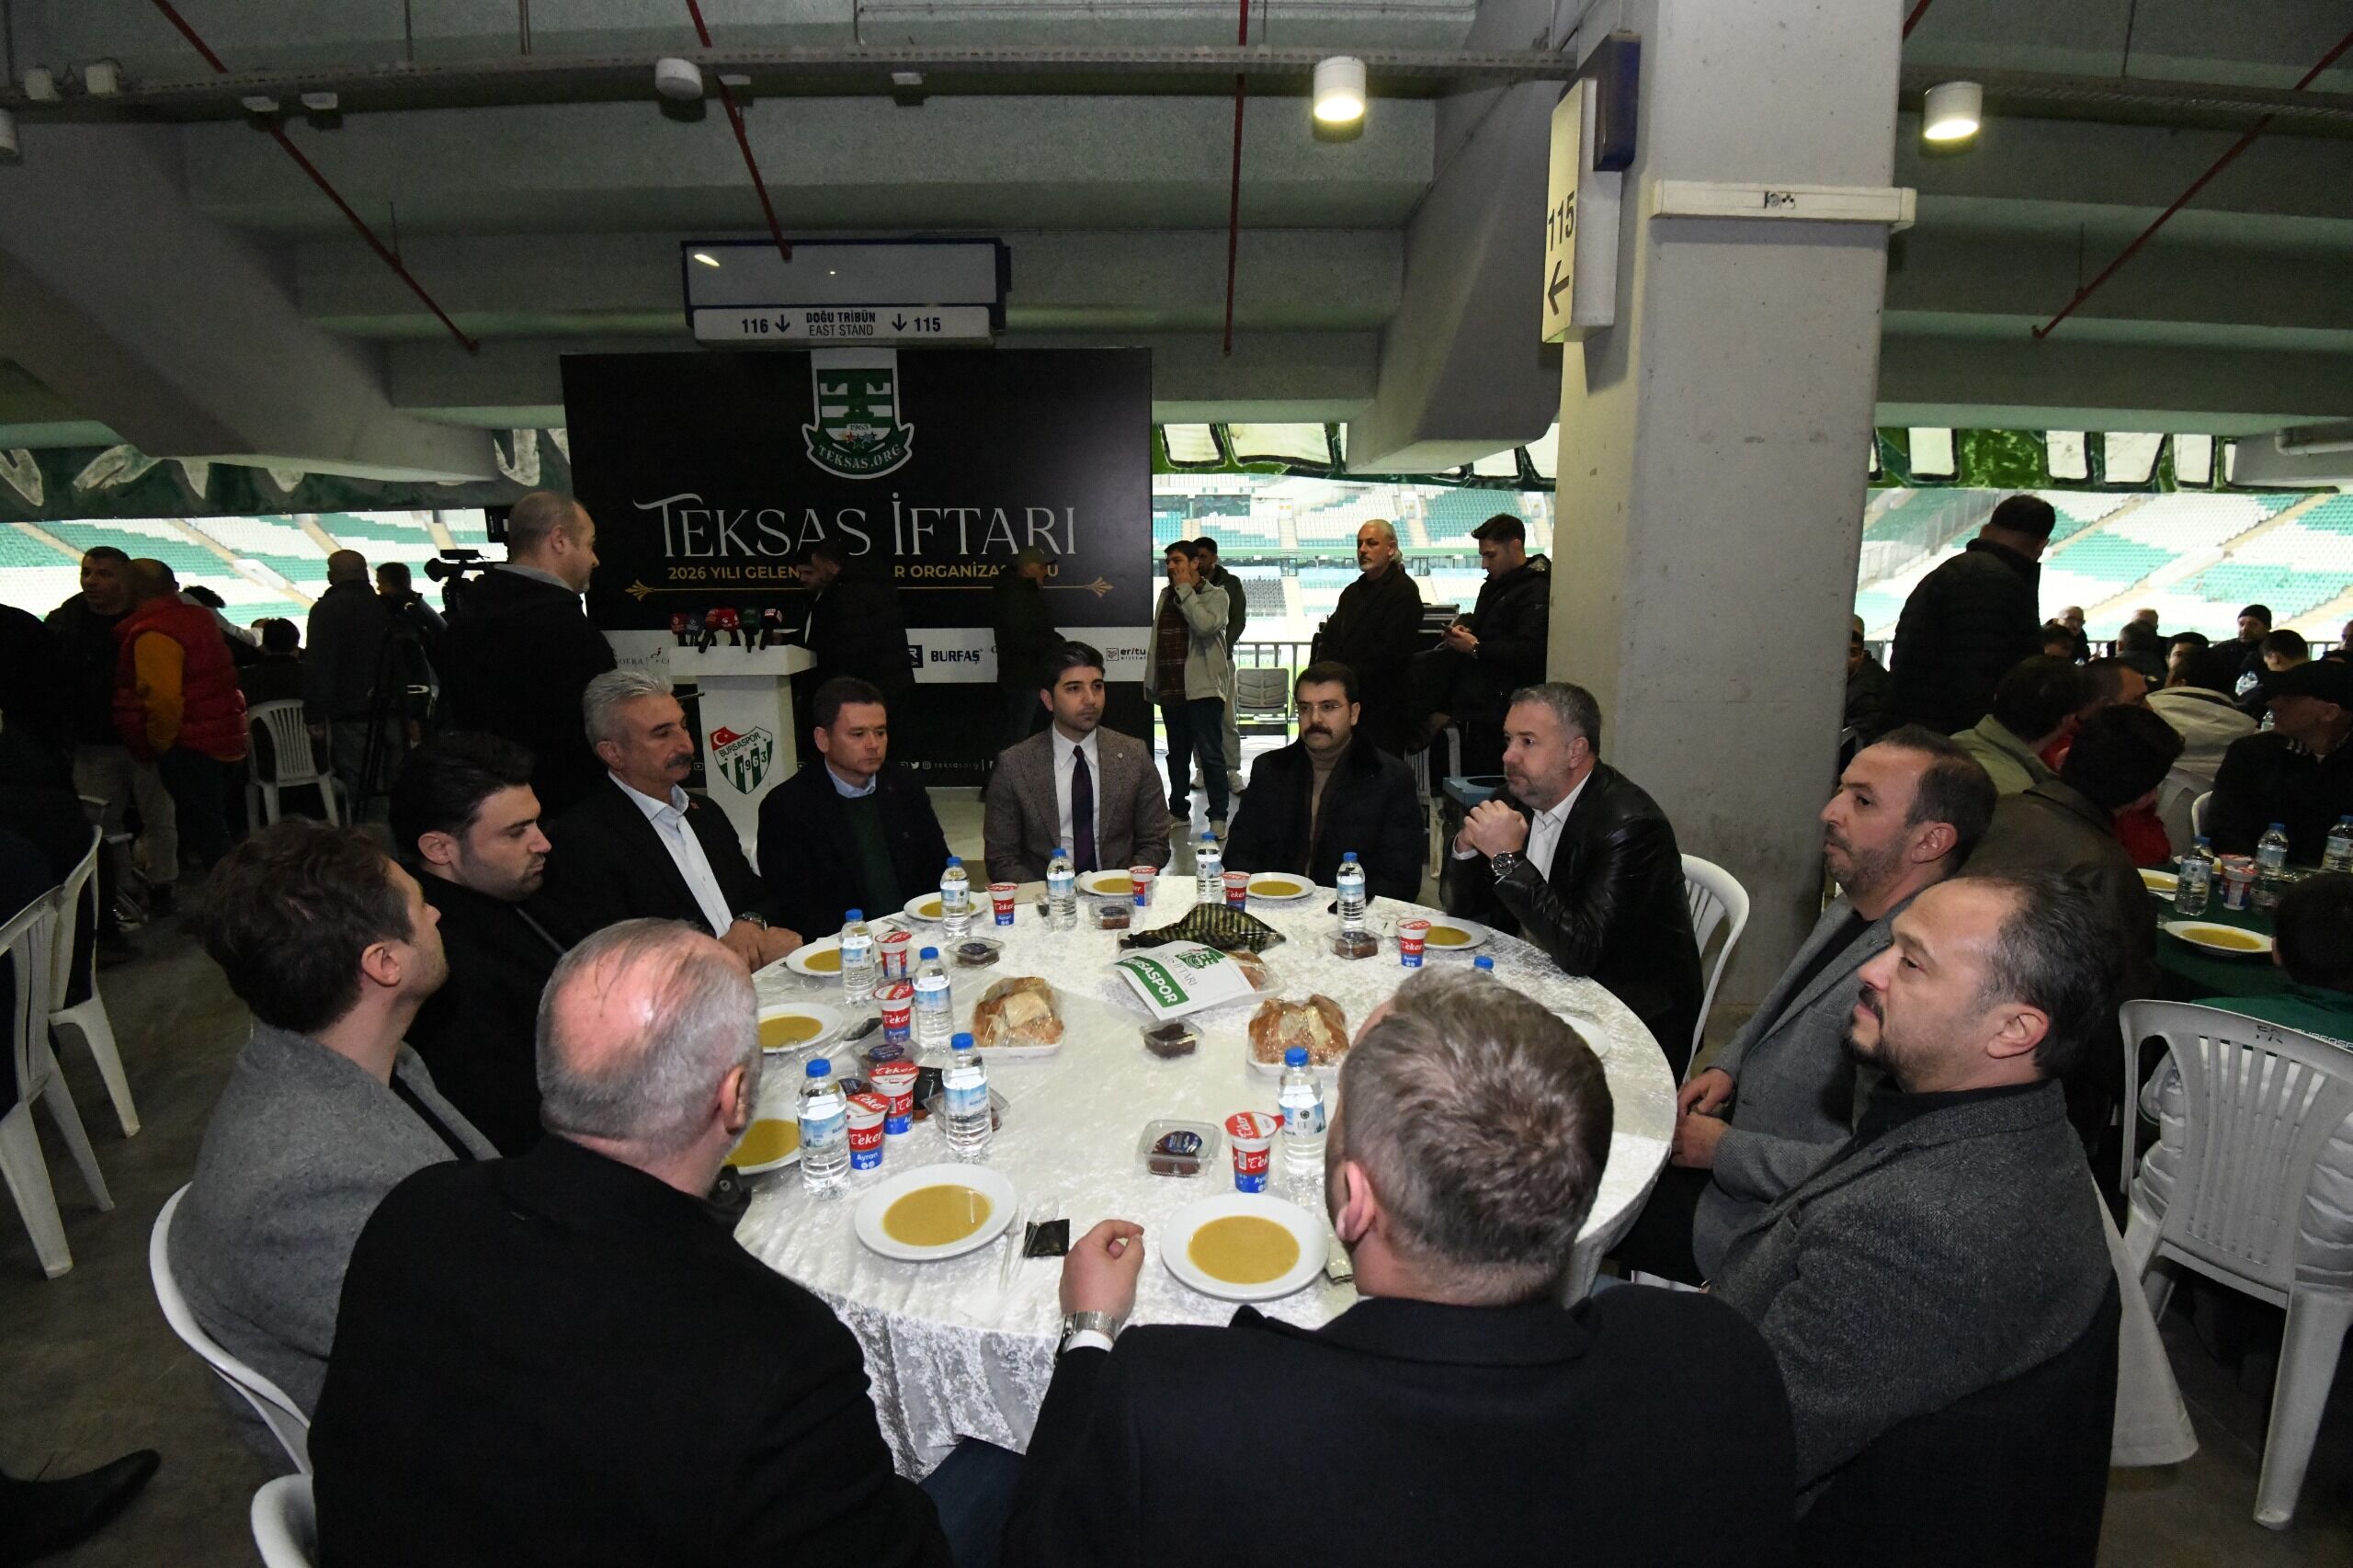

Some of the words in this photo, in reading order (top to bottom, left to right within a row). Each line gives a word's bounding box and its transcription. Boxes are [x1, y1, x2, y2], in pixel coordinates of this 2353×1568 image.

[1549, 189, 1574, 252] 115
[806, 312, 835, 323] DOĞU
[837, 310, 875, 323] TRİBÜN
[914, 317, 941, 332] 115
[742, 319, 768, 333] 116
[809, 324, 835, 336] EAST
[839, 324, 873, 335] STAND
[818, 443, 901, 469] TEKSAS.ORG
[632, 493, 871, 557] TEKSAS
[892, 492, 1076, 555] İFTARI
[668, 567, 706, 579] 2026
[710, 566, 741, 579] YILI
[745, 566, 801, 579] GELEN
[911, 562, 1058, 578] ORGANİZAU
[931, 650, 980, 665] BURFAŞ
[719, 732, 760, 757] BURSASPOR
[738, 751, 767, 774] 1963
[857, 1152, 879, 1162] Ayran
